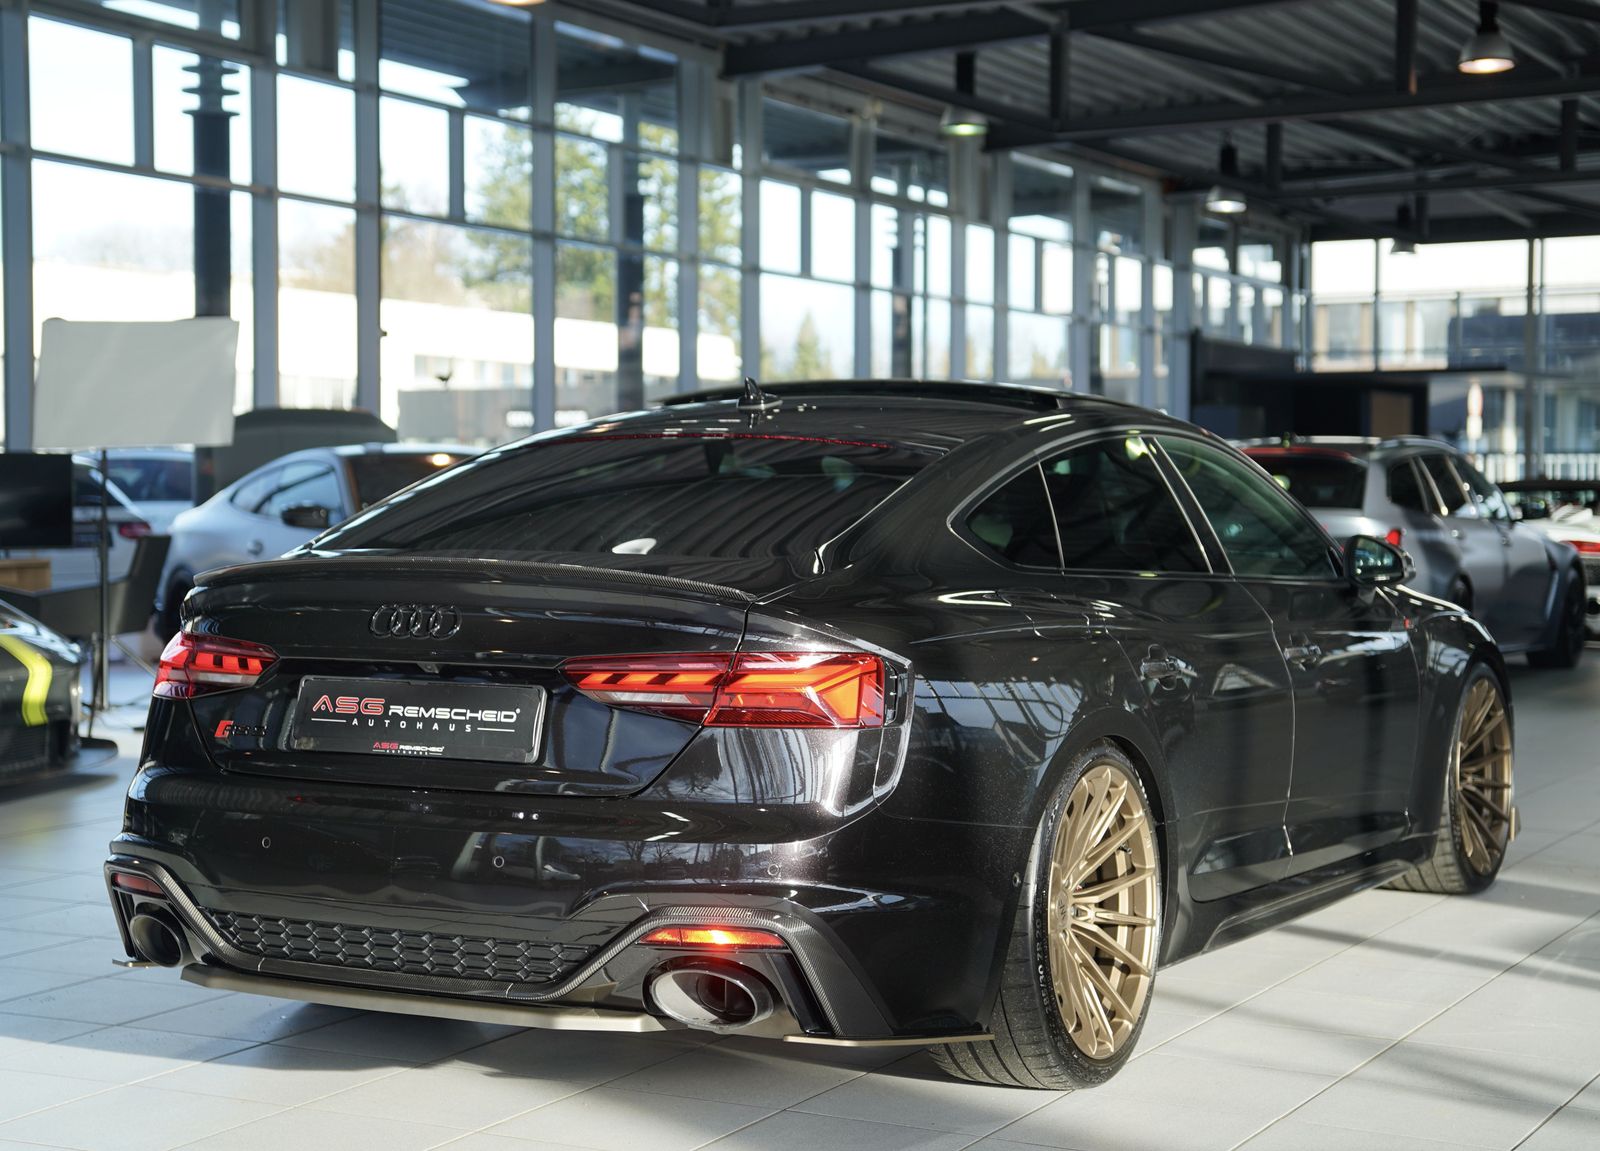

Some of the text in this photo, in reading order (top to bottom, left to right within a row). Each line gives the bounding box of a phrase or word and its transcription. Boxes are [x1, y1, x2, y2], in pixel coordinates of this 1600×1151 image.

[312, 694, 517, 723] ASG REMSCHEID
[352, 718, 472, 732] AUTOHAUS
[373, 742, 399, 750] ASG
